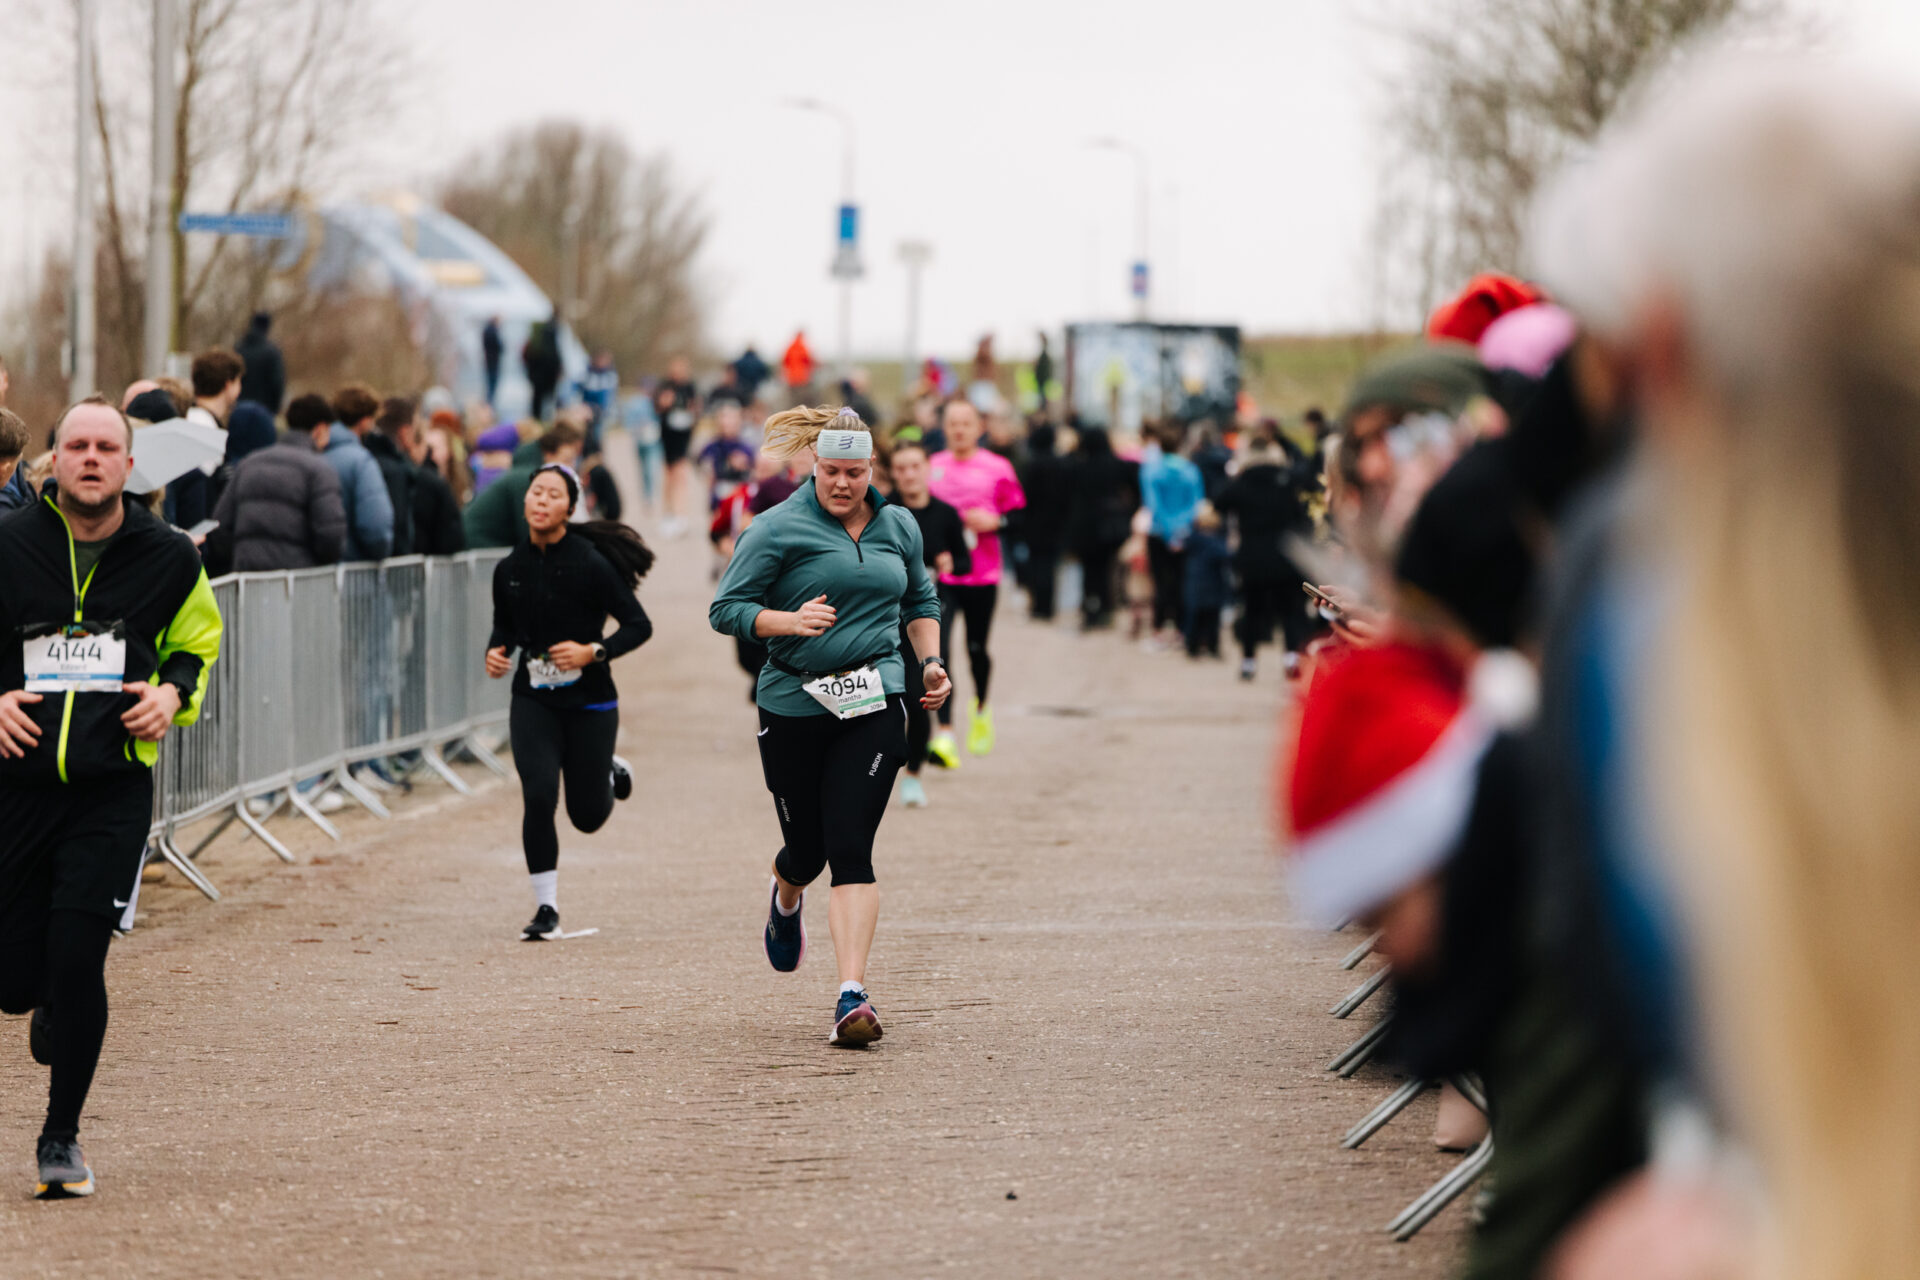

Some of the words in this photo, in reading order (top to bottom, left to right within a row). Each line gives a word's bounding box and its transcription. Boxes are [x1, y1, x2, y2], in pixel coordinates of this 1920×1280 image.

[47, 642, 101, 661] 4144
[819, 675, 868, 696] 3094
[868, 753, 883, 776] FUSION
